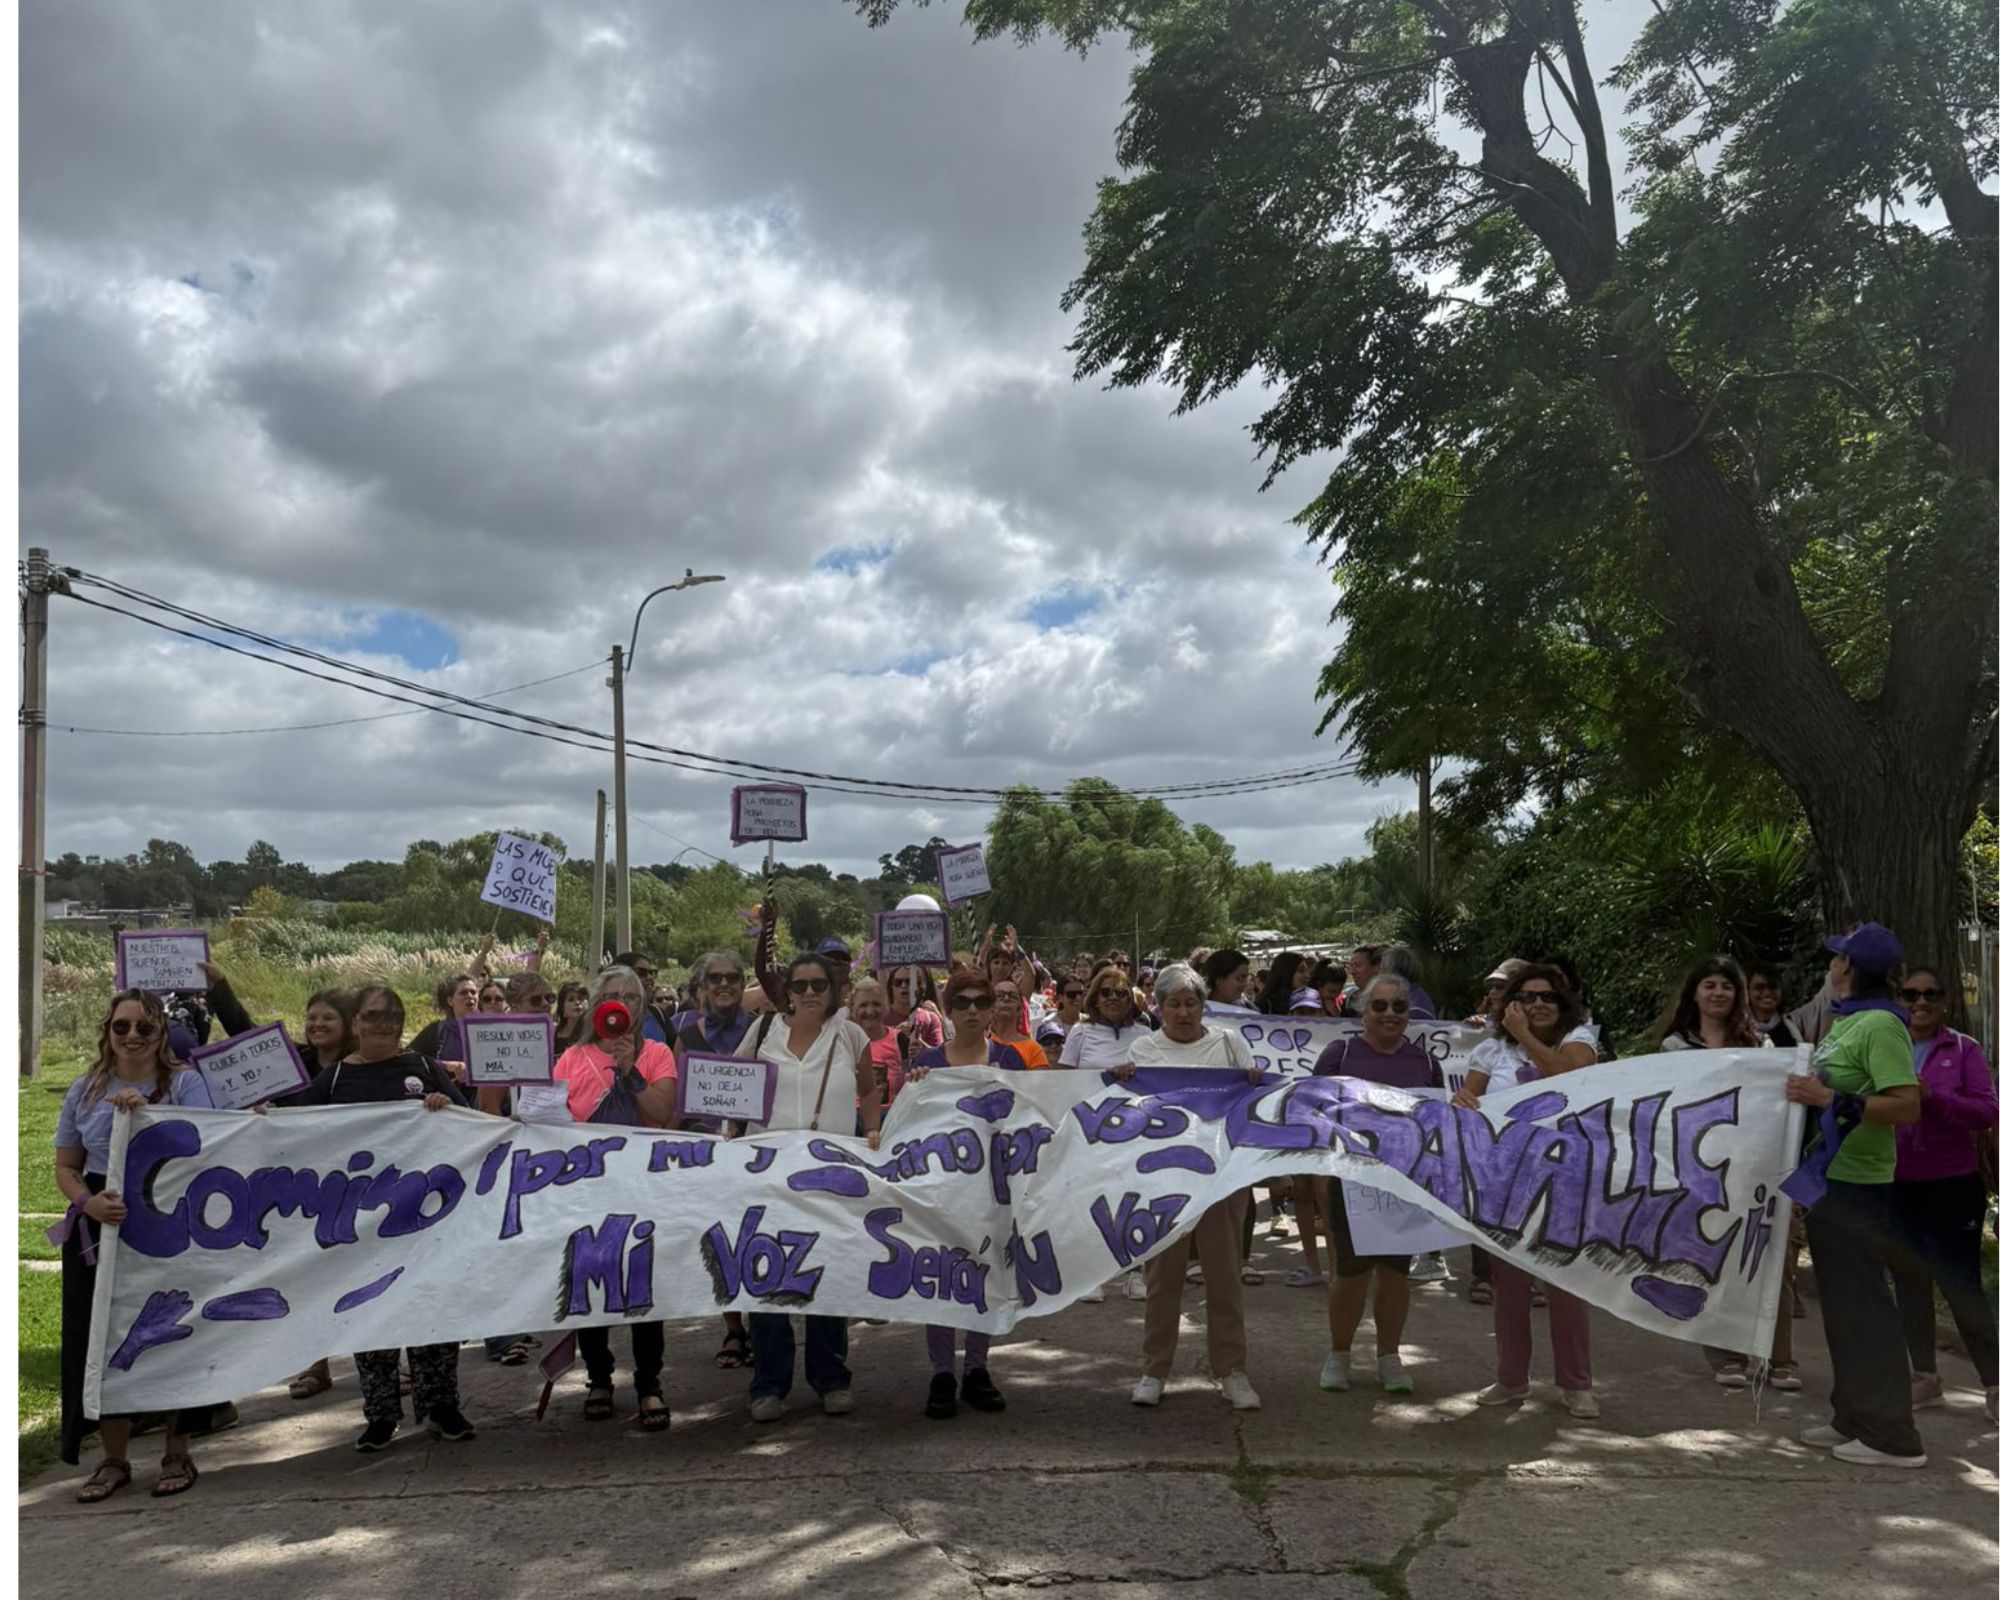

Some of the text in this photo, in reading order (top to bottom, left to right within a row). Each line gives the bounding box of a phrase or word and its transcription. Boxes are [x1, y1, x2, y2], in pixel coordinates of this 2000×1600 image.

[497, 837, 524, 859] LAS
[511, 867, 548, 891] QUE
[240, 1050, 248, 1062] A
[247, 1036, 281, 1056] TODOS
[1240, 1023, 1315, 1054] POR
[497, 1046, 528, 1056] NO LA
[693, 1064, 756, 1077] LA URGENCIA
[698, 1081, 743, 1092] NO DEJA
[567, 1214, 655, 1316] Mi
